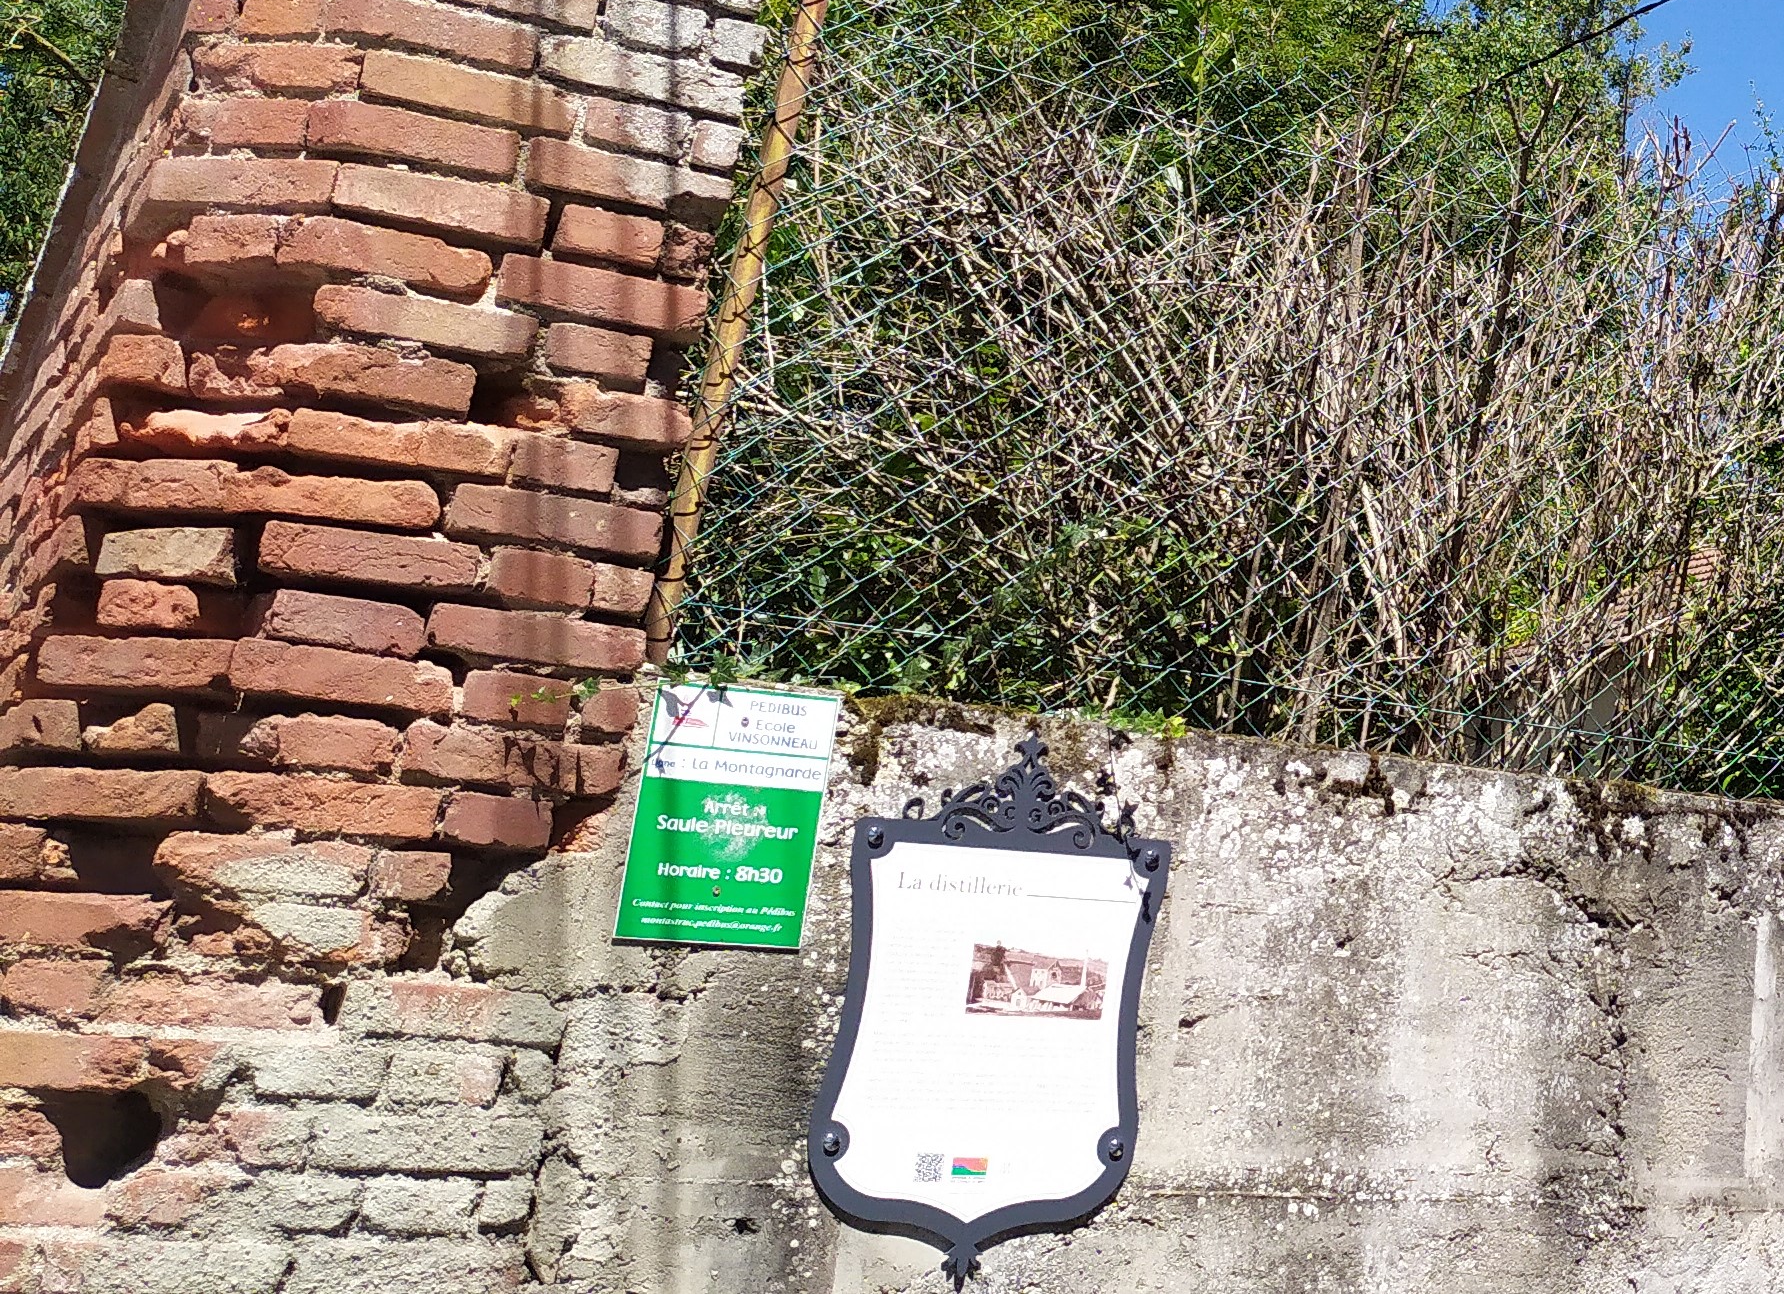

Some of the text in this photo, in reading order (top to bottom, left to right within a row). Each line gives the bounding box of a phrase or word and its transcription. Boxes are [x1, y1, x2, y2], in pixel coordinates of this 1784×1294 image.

[750, 700, 807, 717] PEDIBUS
[756, 720, 796, 734] Ecole
[729, 731, 818, 750] VINSONNEAU
[692, 758, 708, 770] La
[715, 760, 822, 780] Montagnarde
[656, 815, 798, 840] Saule Pleureur
[657, 862, 721, 880] Horaire
[734, 866, 783, 884] 8h30
[898, 871, 1023, 896] La distillerie
